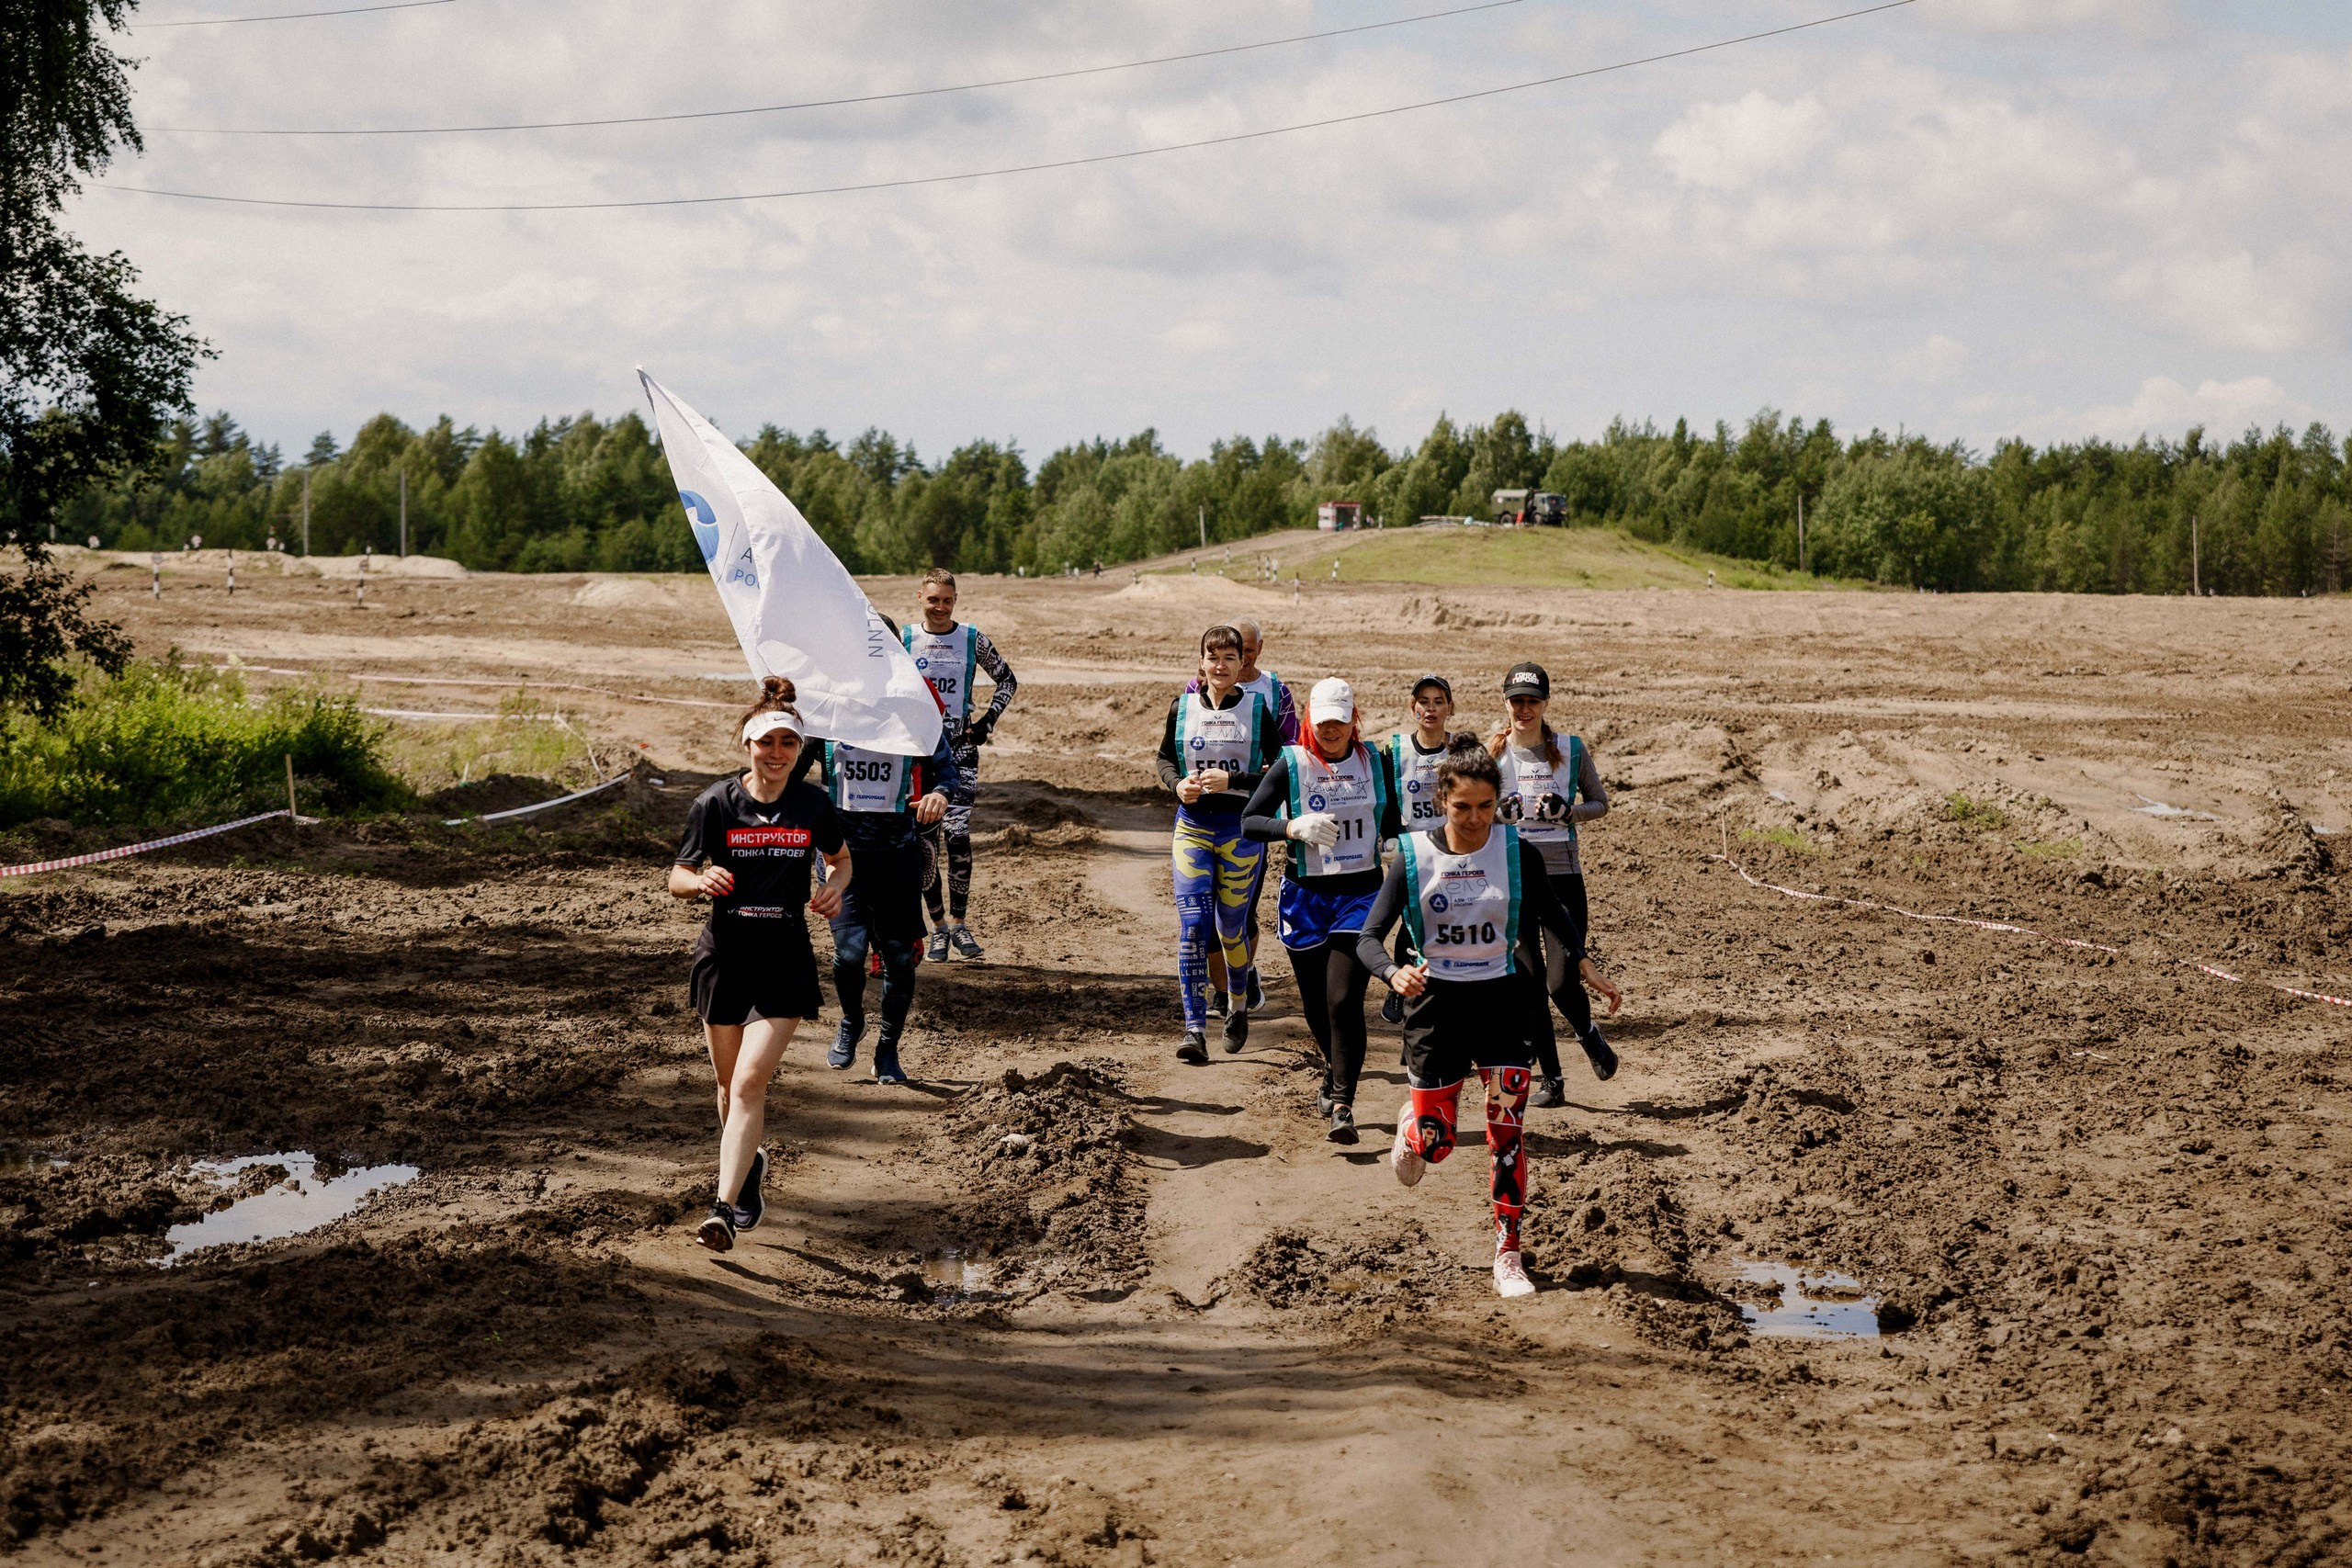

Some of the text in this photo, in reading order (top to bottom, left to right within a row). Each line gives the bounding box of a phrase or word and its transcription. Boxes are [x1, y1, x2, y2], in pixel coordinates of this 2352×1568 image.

[844, 760, 892, 783] 5503
[730, 831, 808, 844] ИНСТРУКТОР
[731, 848, 806, 858] ГОНКА ГЕРОЕВ
[1435, 921, 1496, 945] 5510
